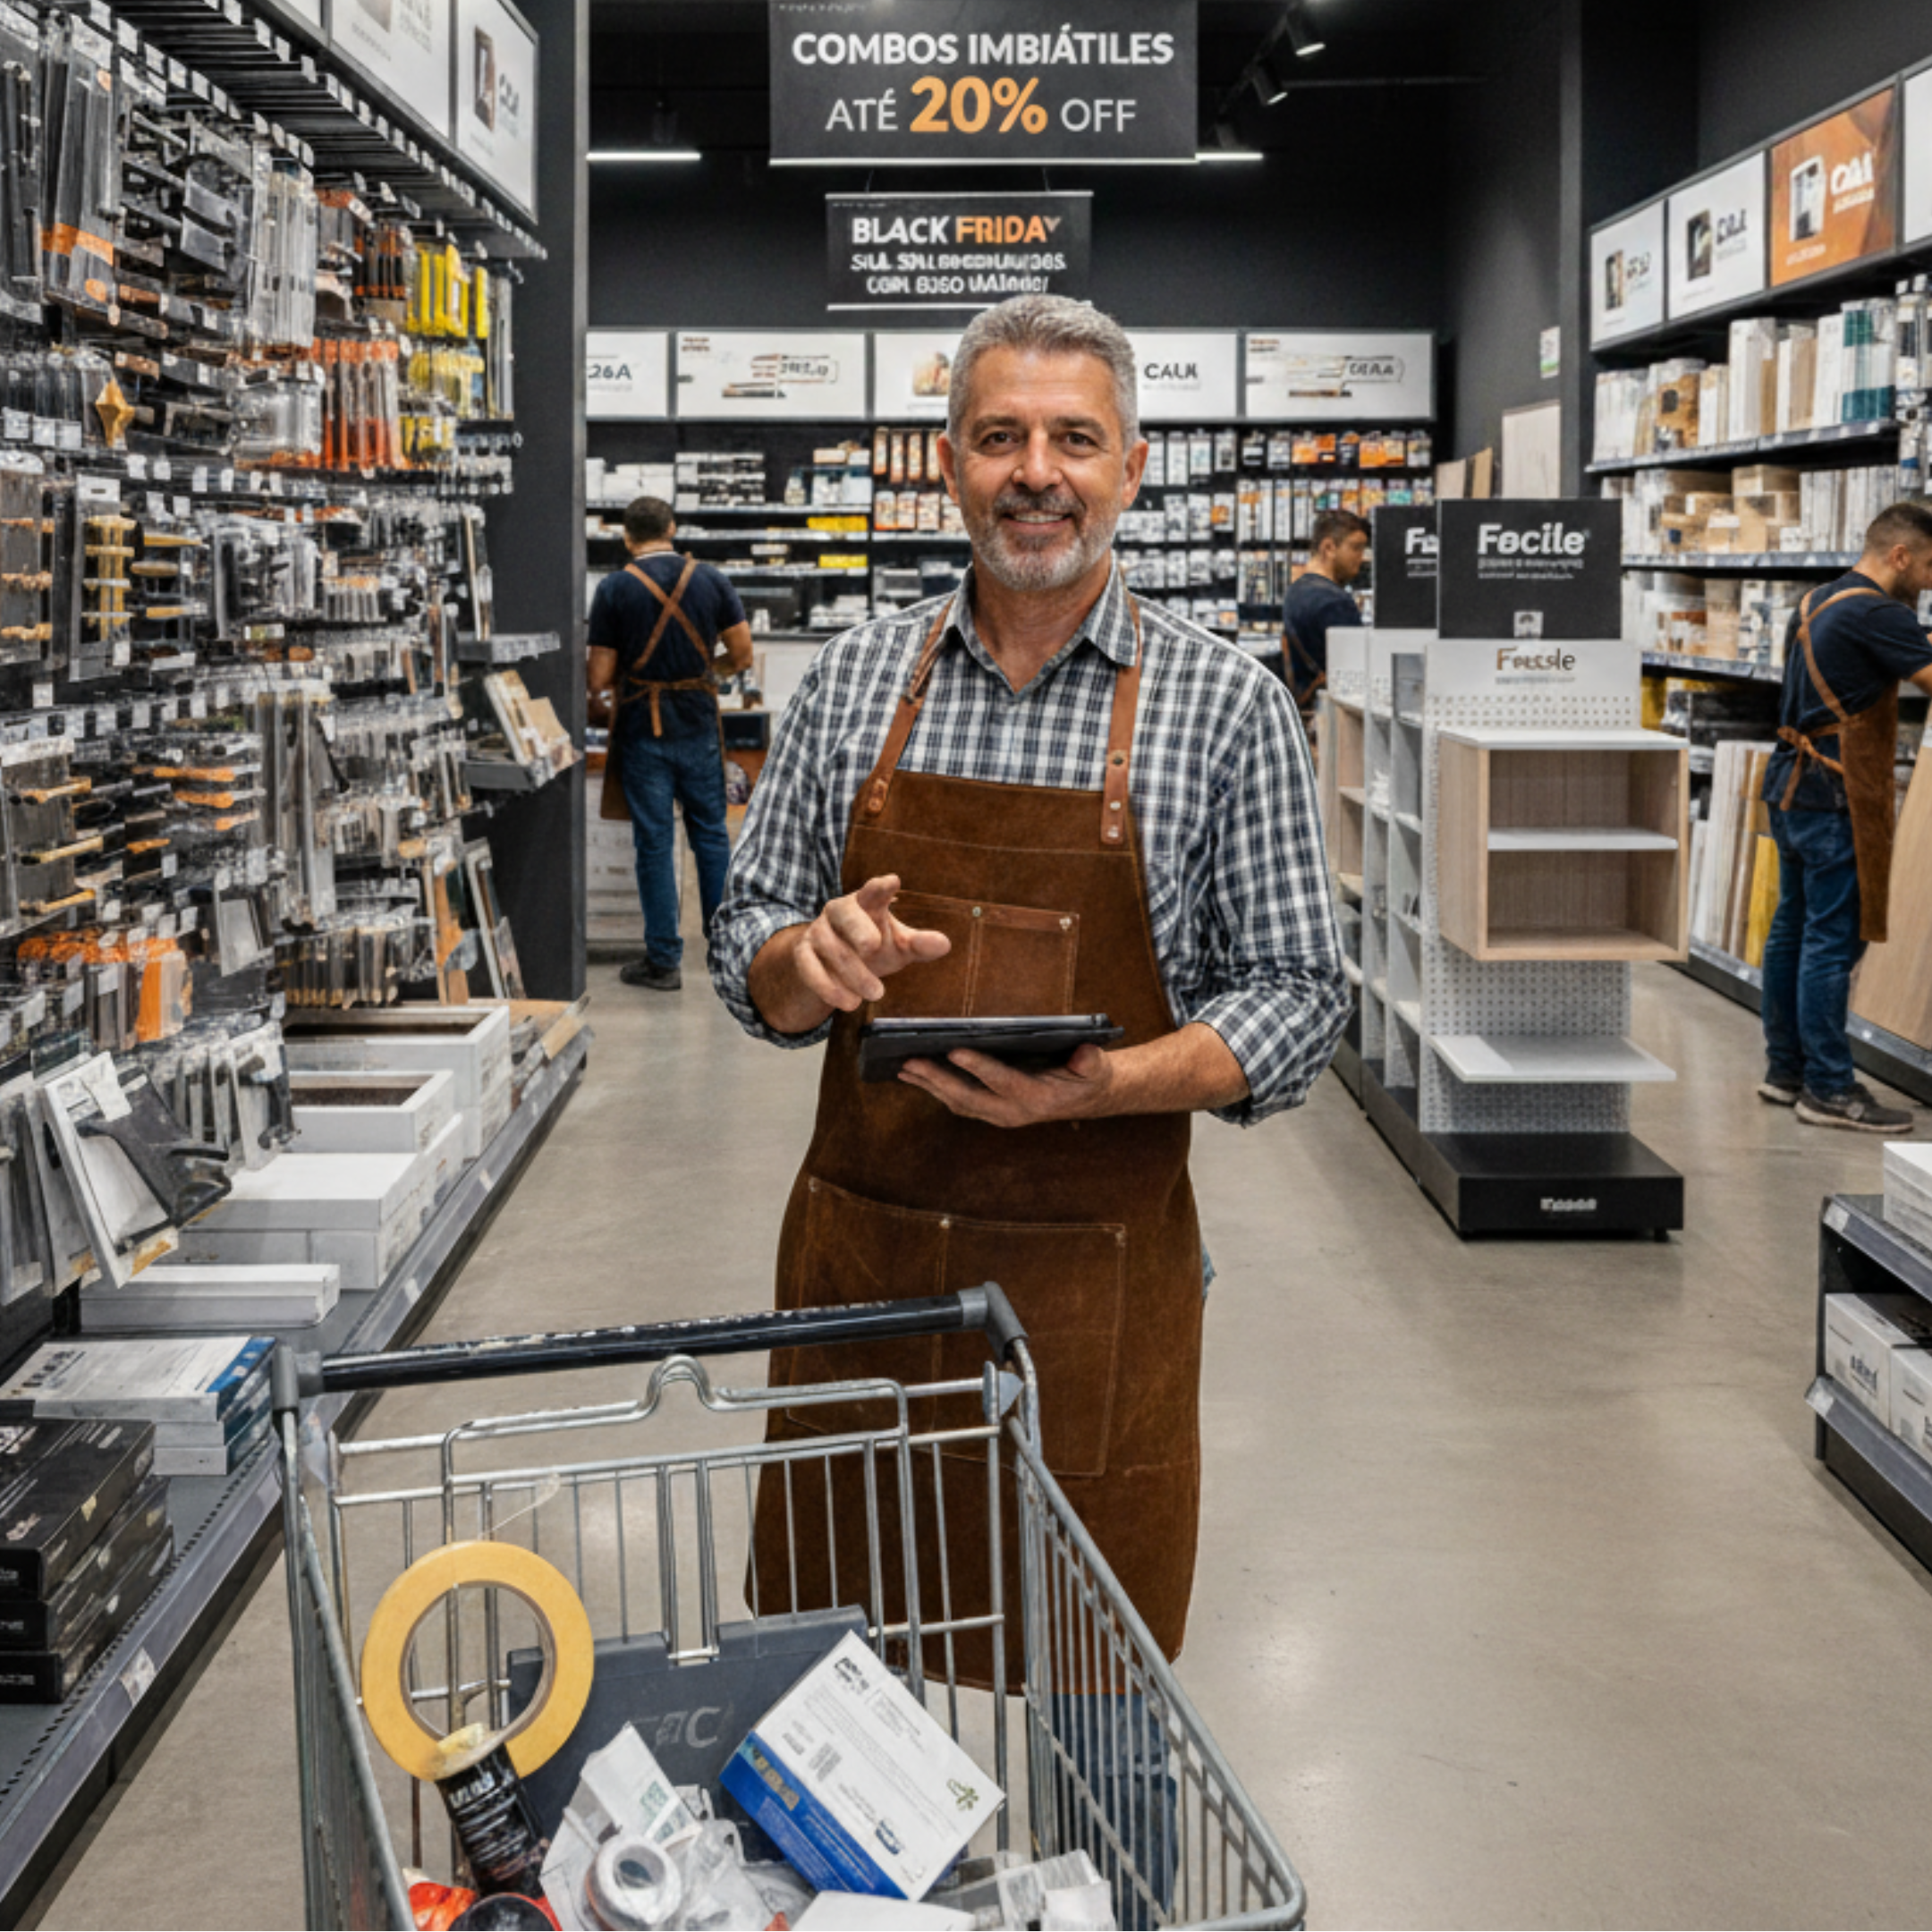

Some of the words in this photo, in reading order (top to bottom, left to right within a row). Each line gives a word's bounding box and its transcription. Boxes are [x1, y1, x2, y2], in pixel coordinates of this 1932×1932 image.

[792, 32, 960, 65] COMBOS
[968, 23, 1175, 65] IMBIÁTILES
[825, 88, 899, 131] ATÉ
[909, 75, 1048, 134] 20%
[1060, 98, 1137, 132] OFF
[852, 216, 950, 244] BLACK
[955, 215, 1062, 244] FRIDAY
